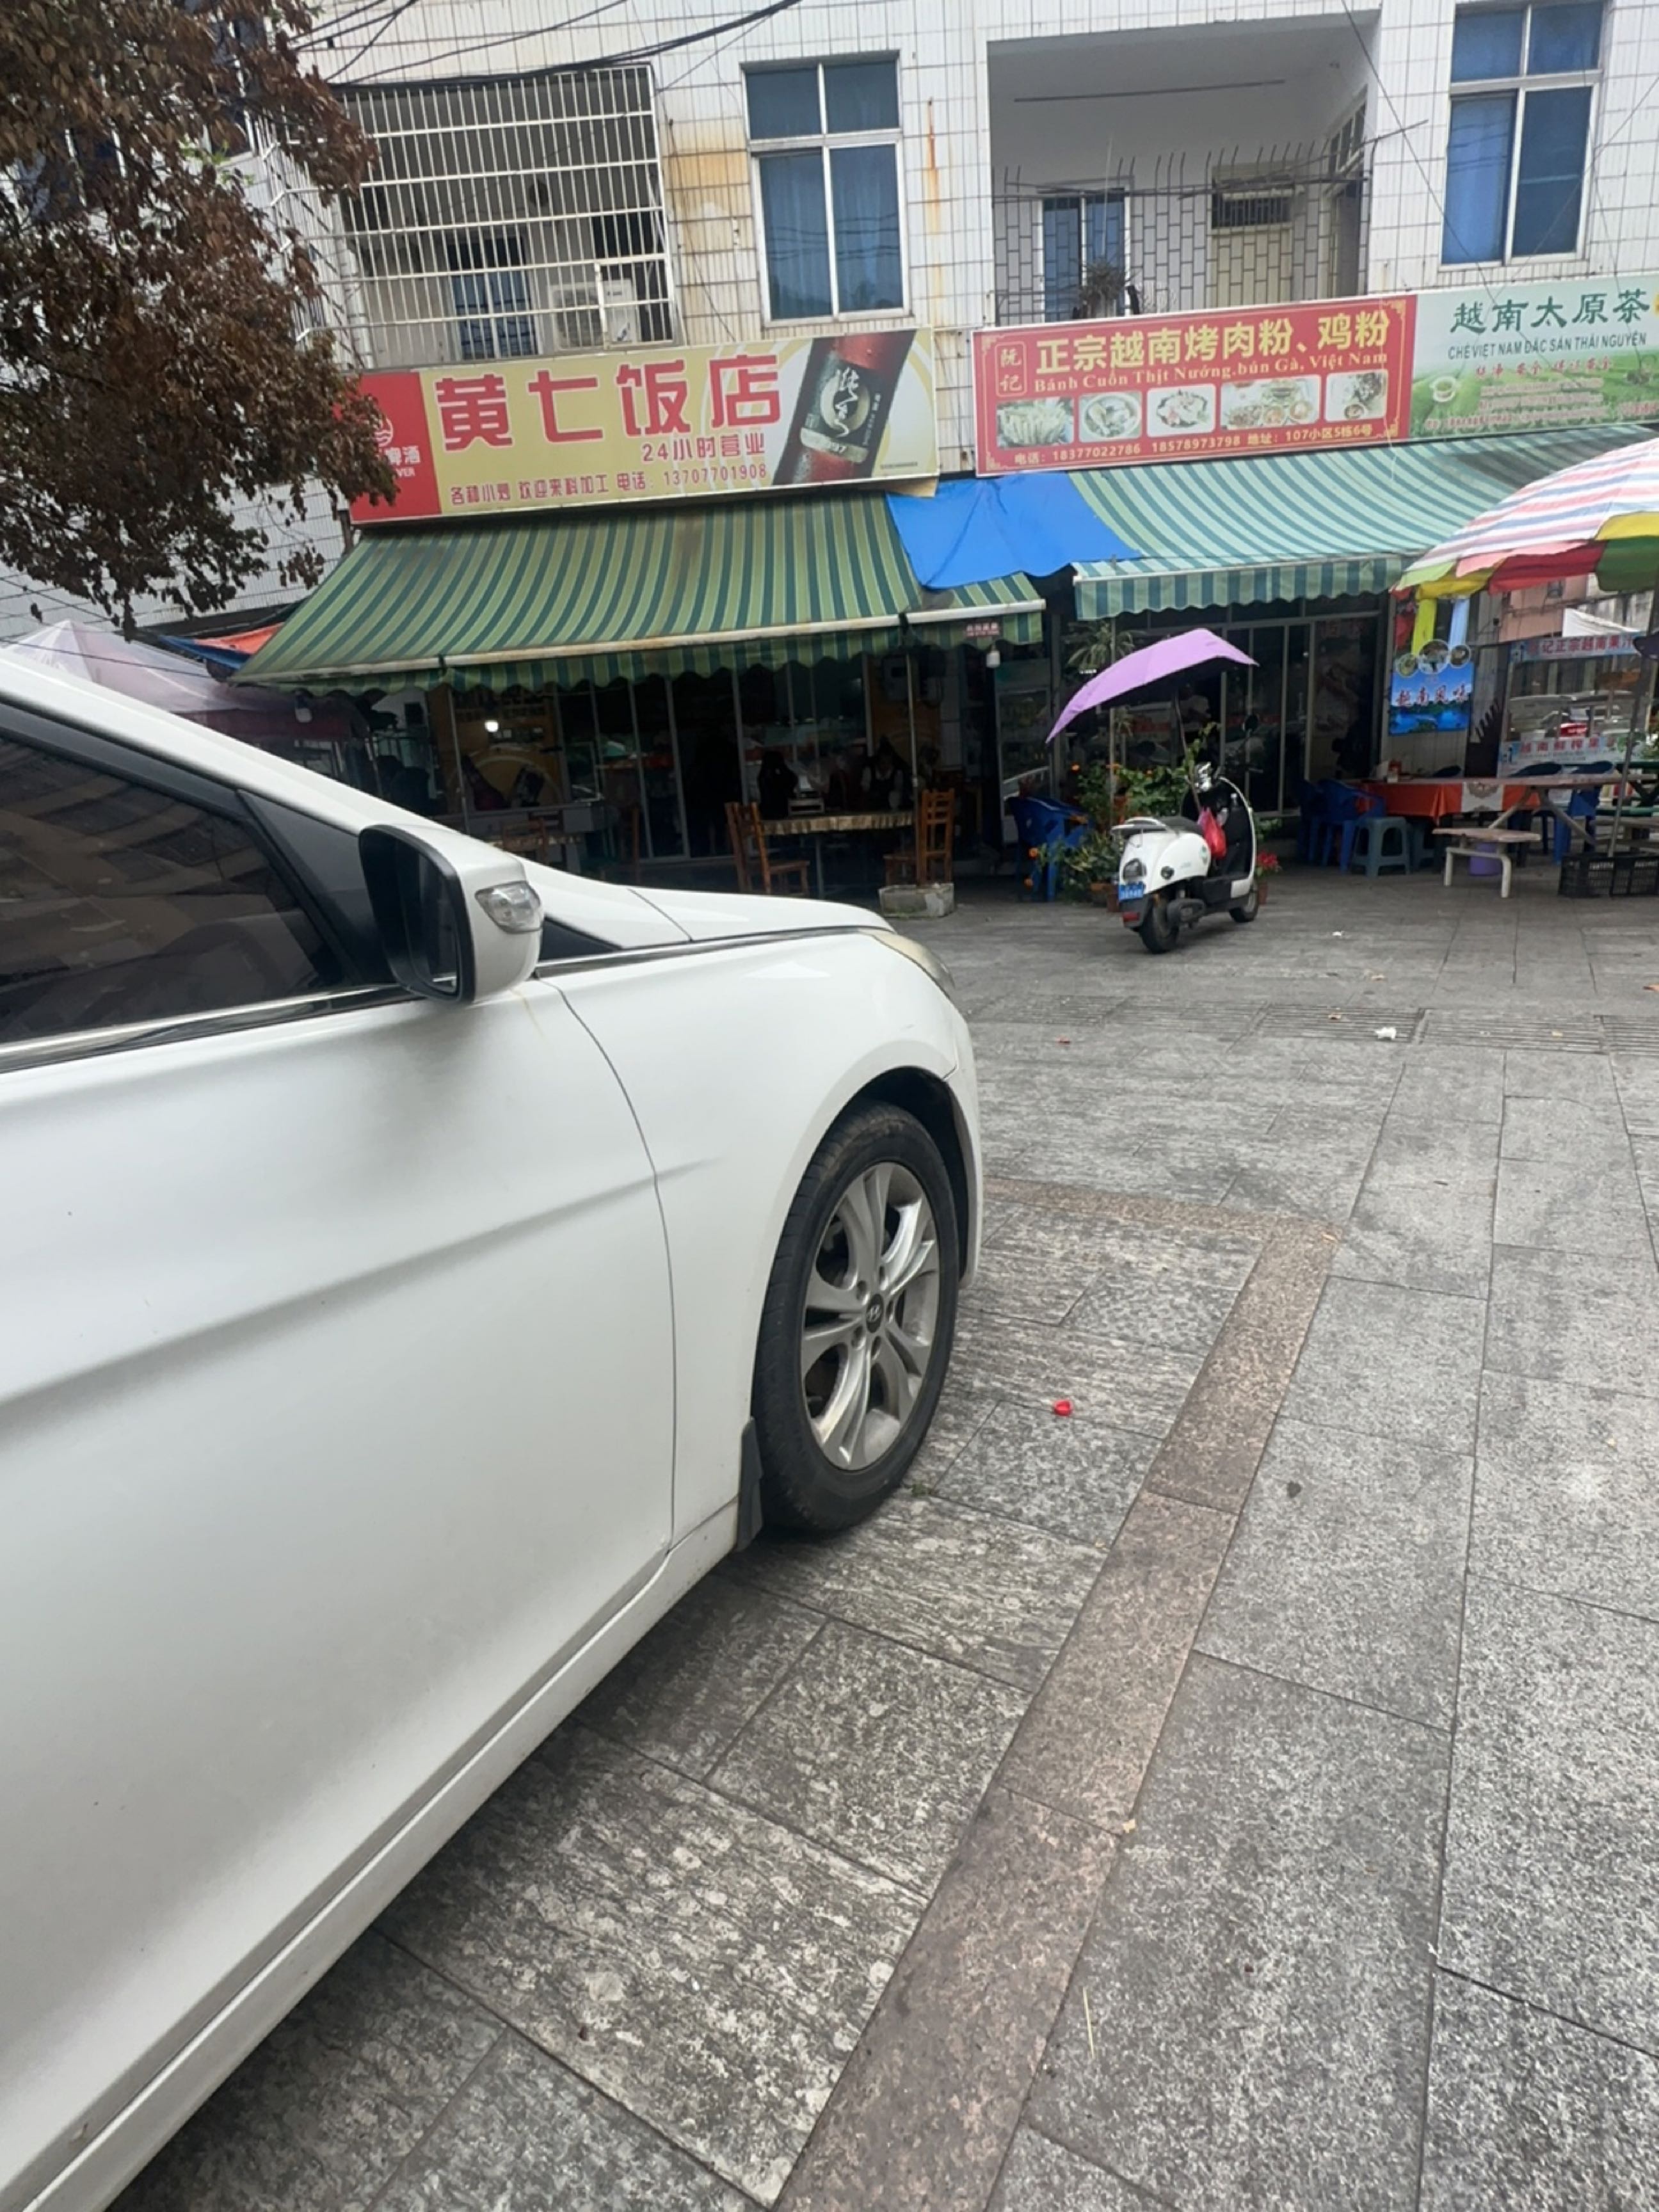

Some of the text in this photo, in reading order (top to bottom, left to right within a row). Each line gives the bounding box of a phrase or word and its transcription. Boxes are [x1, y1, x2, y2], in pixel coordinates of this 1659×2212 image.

[1450, 288, 1651, 334] 越南太原茶
[1036, 310, 1390, 374] 正宗越南烤肉粉、鸡粉
[1498, 341, 1523, 355] NAM
[1000, 348, 1023, 392] 阮记
[1034, 376, 1078, 392] Bánh
[1349, 352, 1388, 364] Nam
[435, 354, 780, 451] 黄七饭店
[642, 433, 765, 462] 24小时营业
[1053, 443, 1141, 461] 18377022786
[1152, 435, 1241, 453] 18578973798
[664, 463, 767, 486] 13707701908
